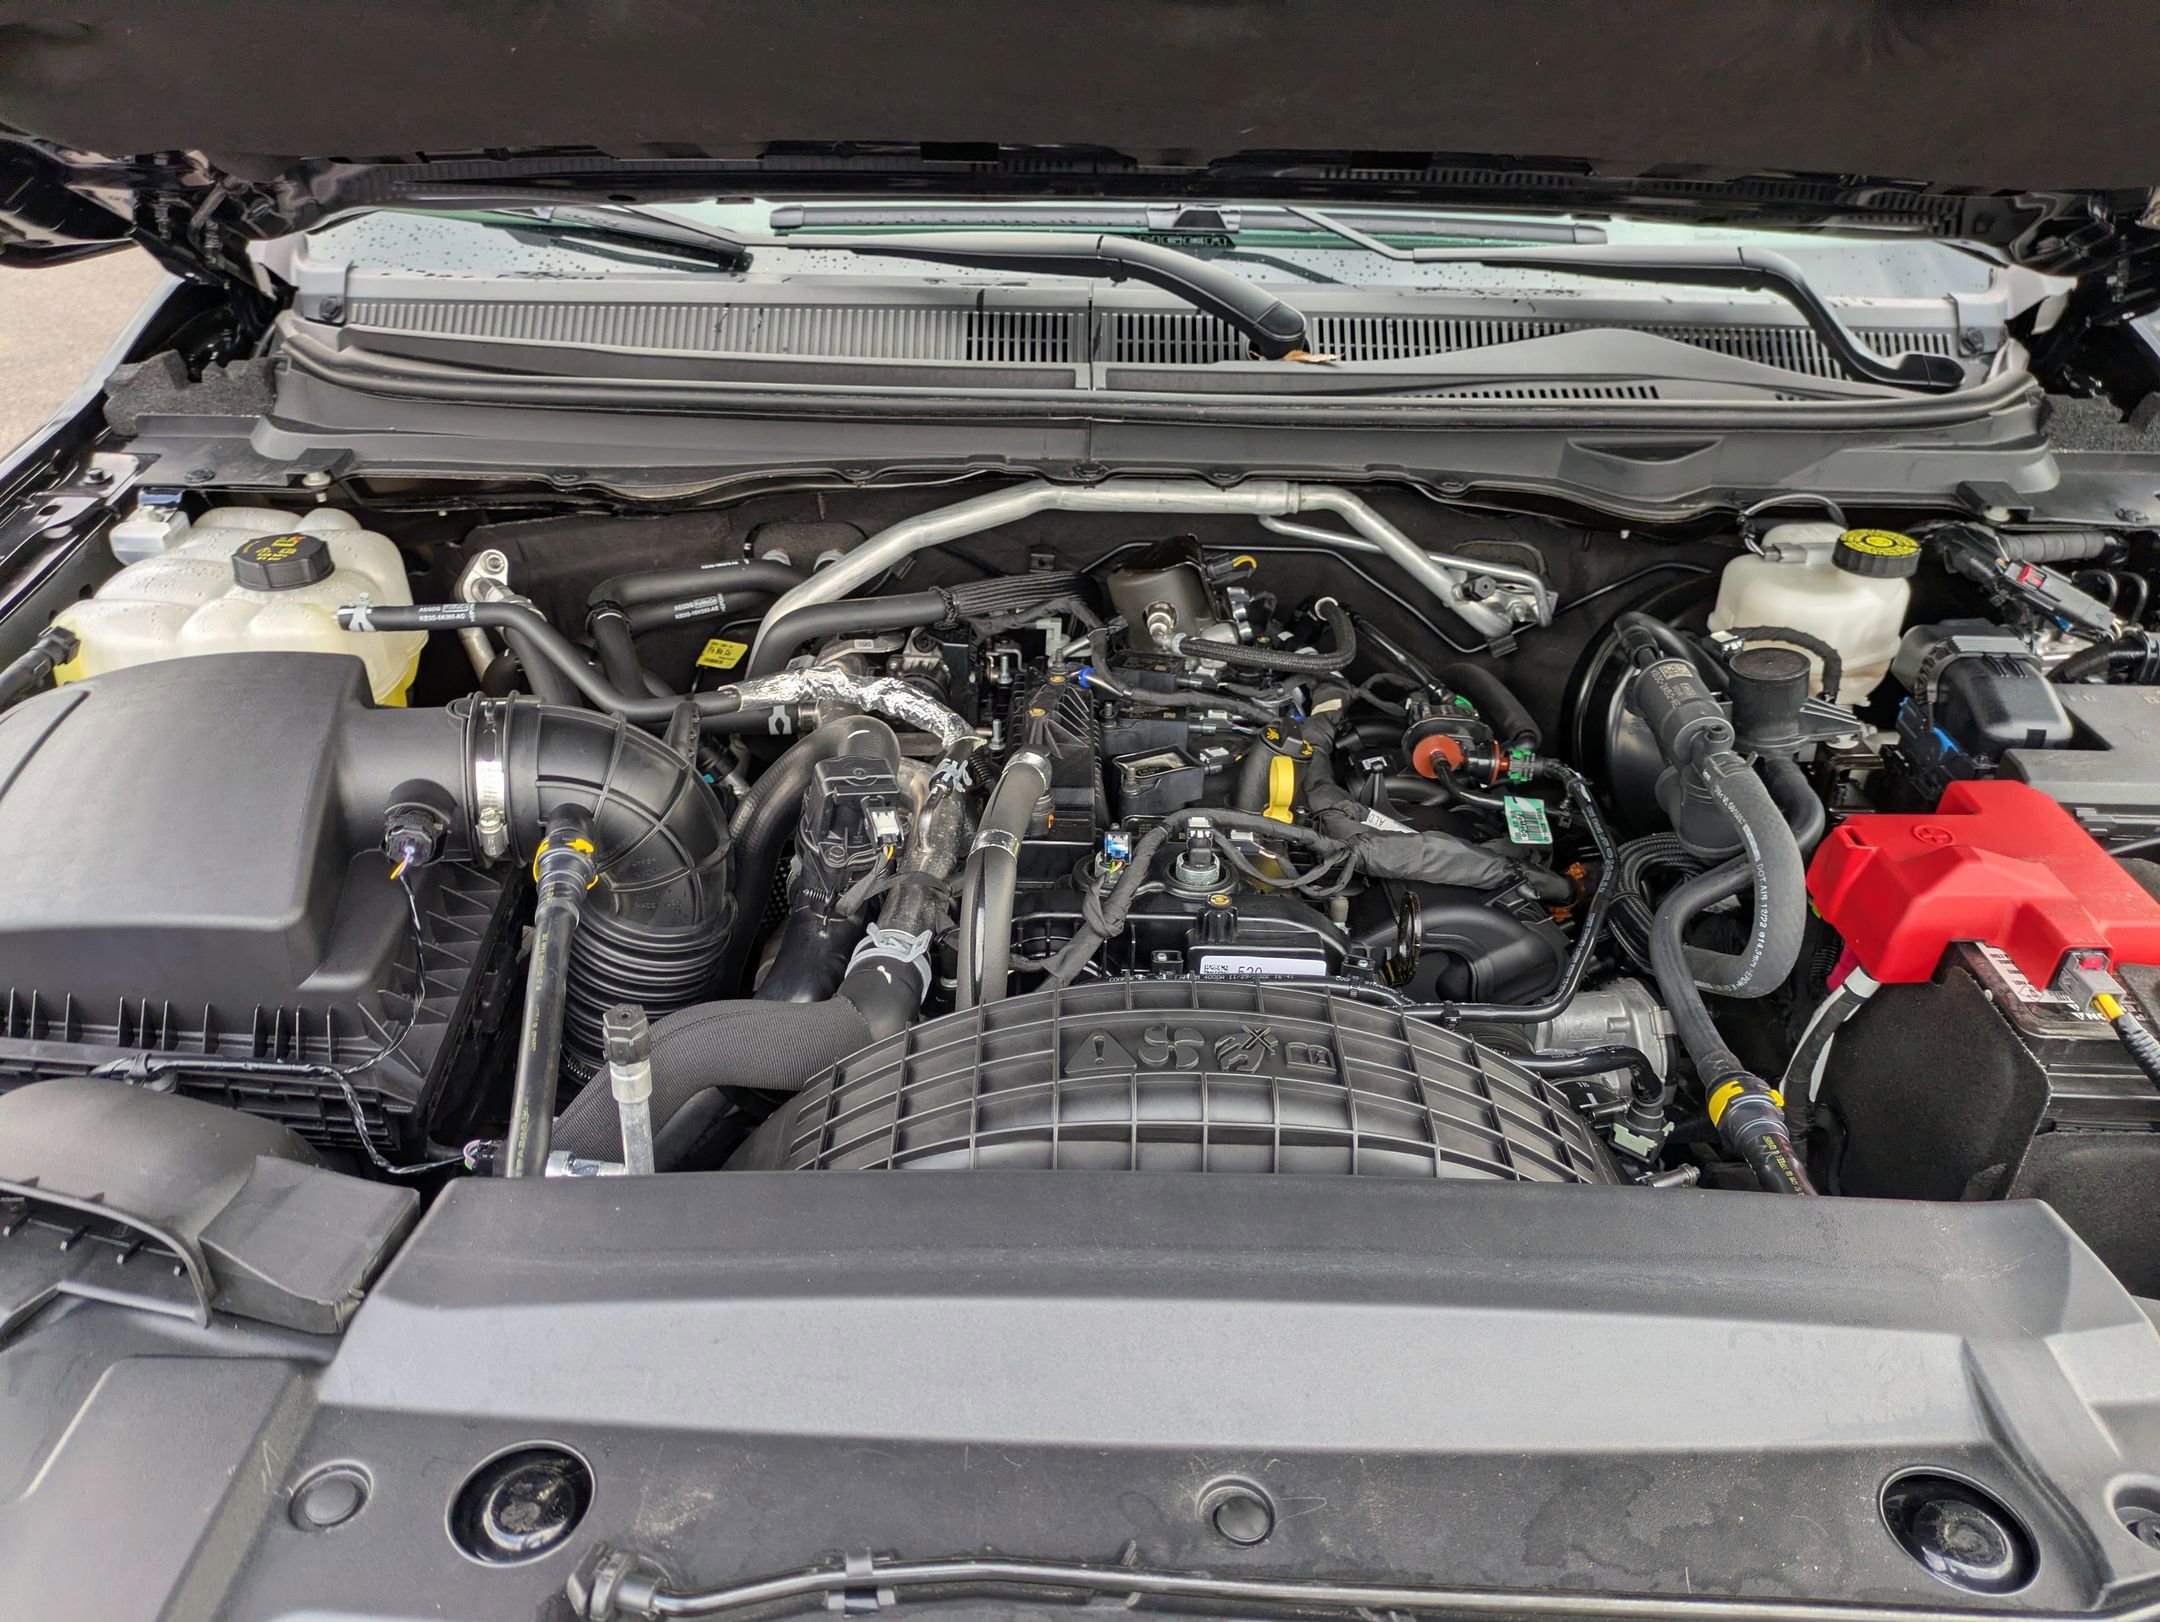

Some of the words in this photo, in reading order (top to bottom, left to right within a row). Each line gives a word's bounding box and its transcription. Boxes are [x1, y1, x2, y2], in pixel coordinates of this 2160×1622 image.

[1368, 813, 1386, 827] ALD
[1756, 863, 1767, 882] DOT
[1759, 904, 1769, 928] 12/22
